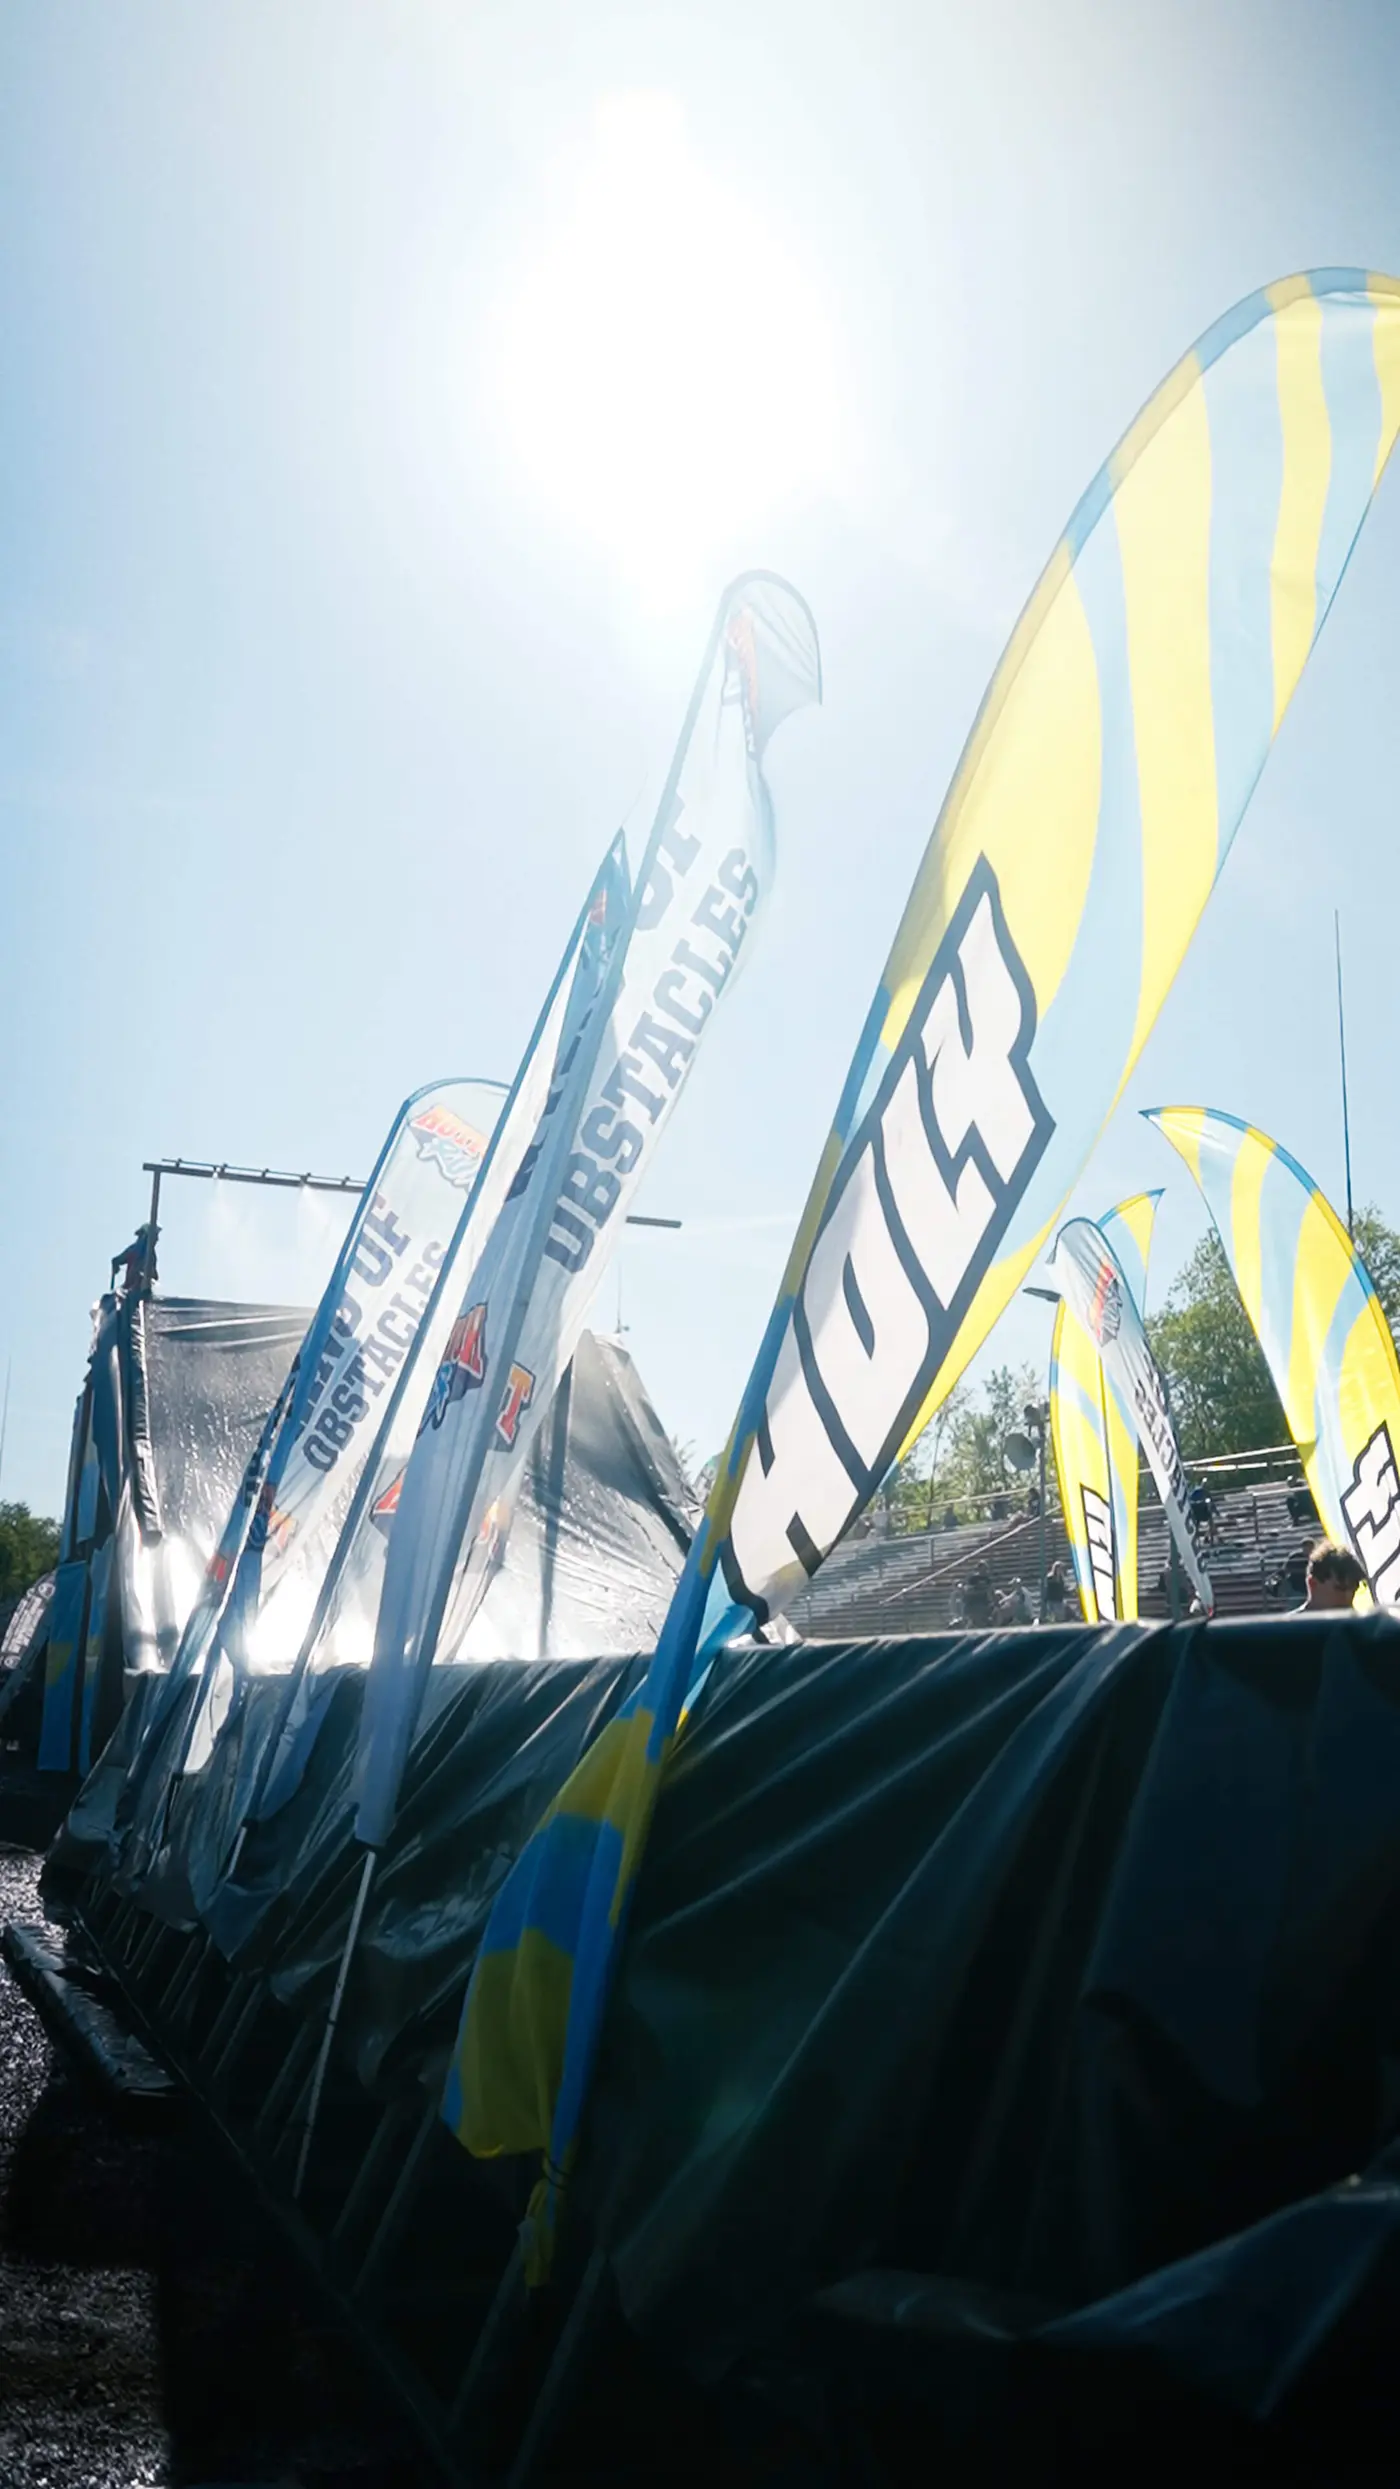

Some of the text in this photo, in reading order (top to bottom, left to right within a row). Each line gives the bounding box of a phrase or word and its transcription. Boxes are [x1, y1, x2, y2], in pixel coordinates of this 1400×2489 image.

[544, 847, 759, 1275] OBSTACLES
[302, 1241, 449, 1472] OBSTACLES
[352, 1191, 412, 1287] OF
[722, 853, 1056, 1635] HOLY
